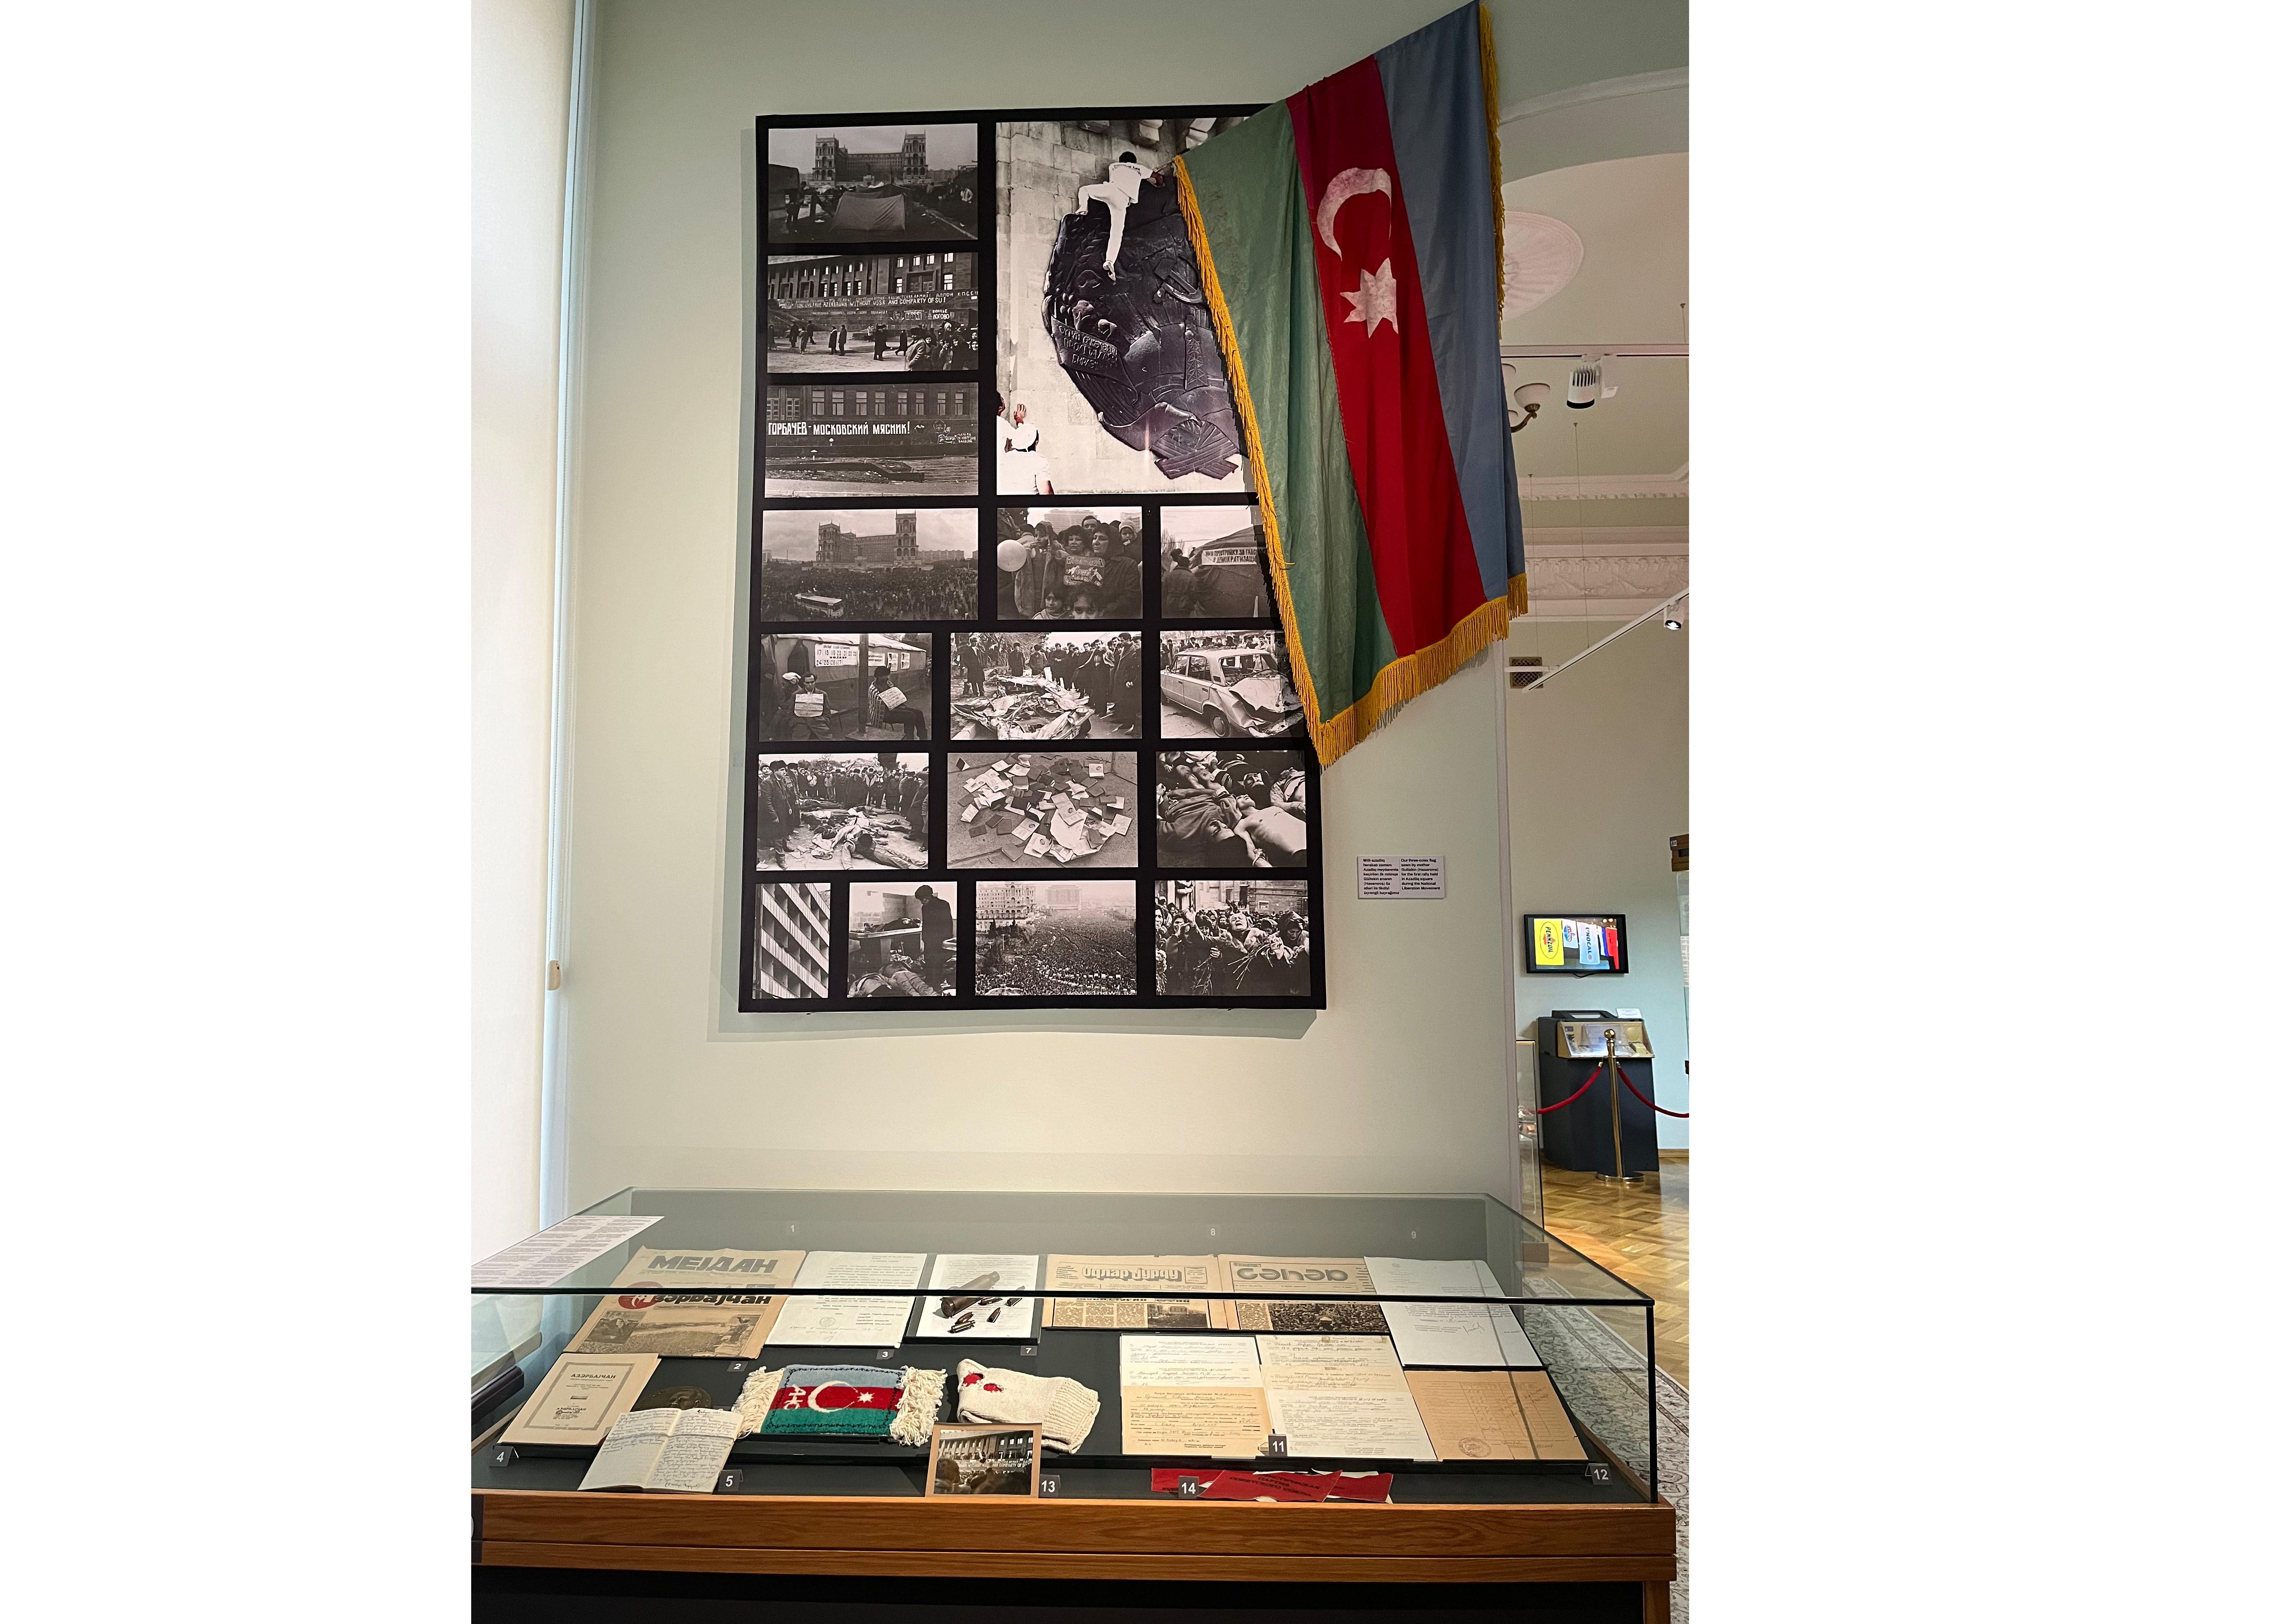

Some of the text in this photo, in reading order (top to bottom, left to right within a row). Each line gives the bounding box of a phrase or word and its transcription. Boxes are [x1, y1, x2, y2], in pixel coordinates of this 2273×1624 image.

[813, 421, 869, 435] МОСКОВСКИЙ
[872, 420, 910, 435] МЯСНИК!
[1545, 926, 1553, 953] PENNZOIL
[1211, 1228, 1216, 1236] 8
[646, 1255, 778, 1274] МЕЈДАН
[1272, 1440, 1284, 1452] 11
[496, 1451, 505, 1462] 4
[1594, 1469, 1609, 1480] 12
[725, 1475, 734, 1487] 5
[1041, 1480, 1056, 1493] 13
[1181, 1482, 1196, 1494] 14
